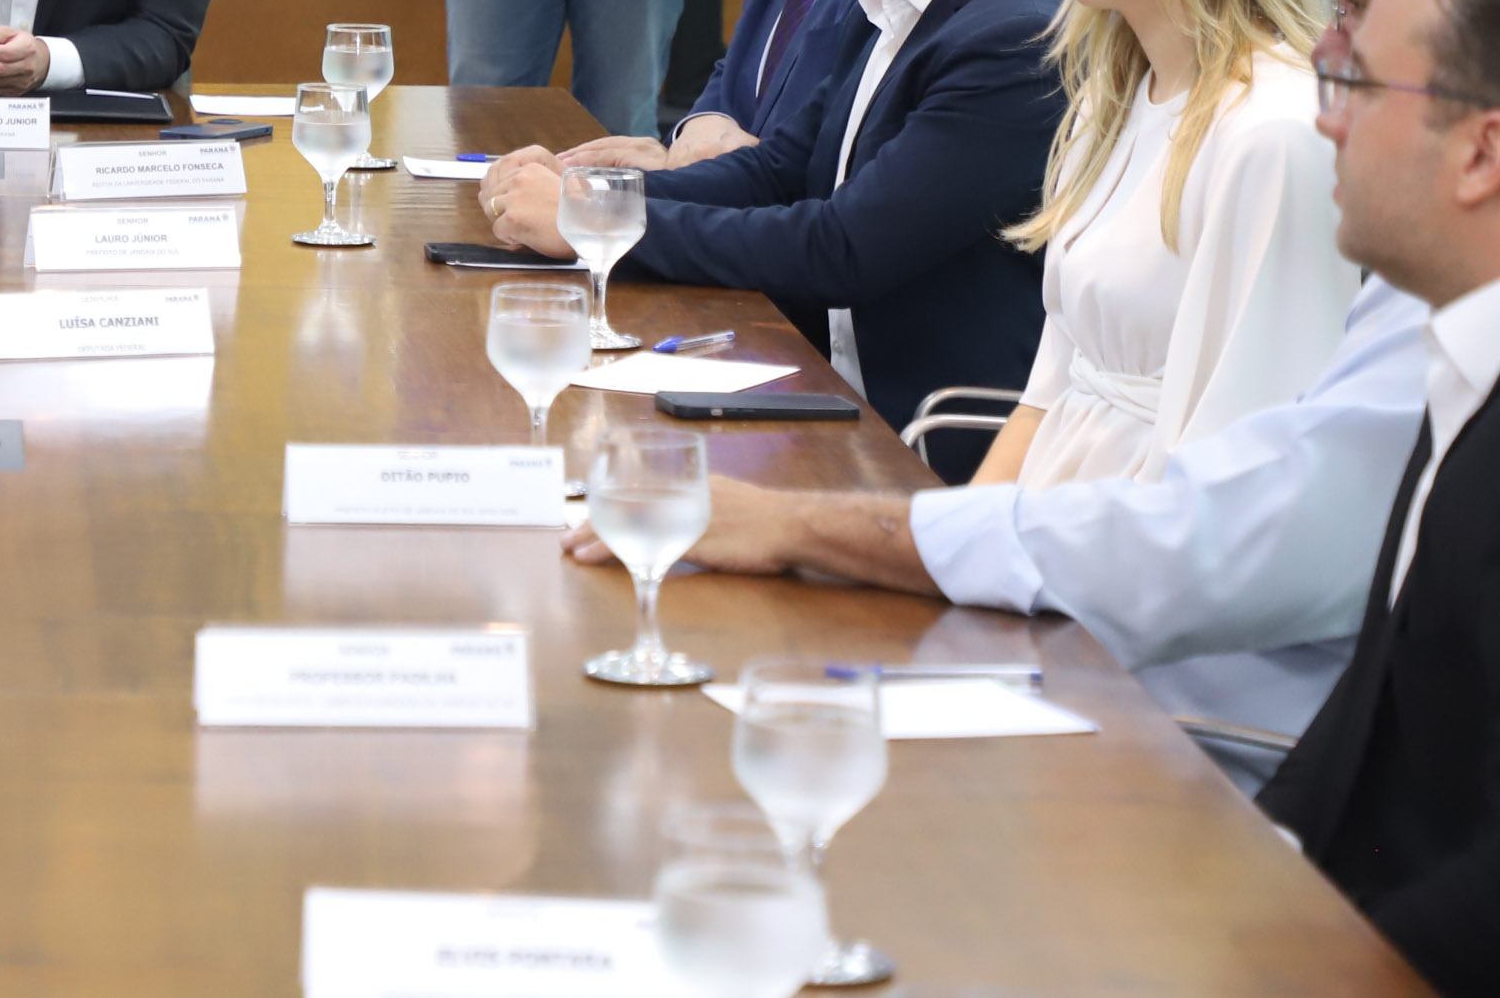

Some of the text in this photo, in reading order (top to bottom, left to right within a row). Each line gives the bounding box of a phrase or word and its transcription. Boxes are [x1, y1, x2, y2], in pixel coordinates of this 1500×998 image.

[5, 117, 38, 125] JUNIOR
[95, 162, 224, 175] RICARDO MARCELO FONSECA
[117, 217, 148, 225] SENHOR
[188, 215, 221, 223] PARANÁ
[95, 232, 168, 244] LAURO JÚNIOR
[59, 315, 160, 329] LUÍSA CANZIANI
[381, 469, 470, 483] DITÃO PUPIO
